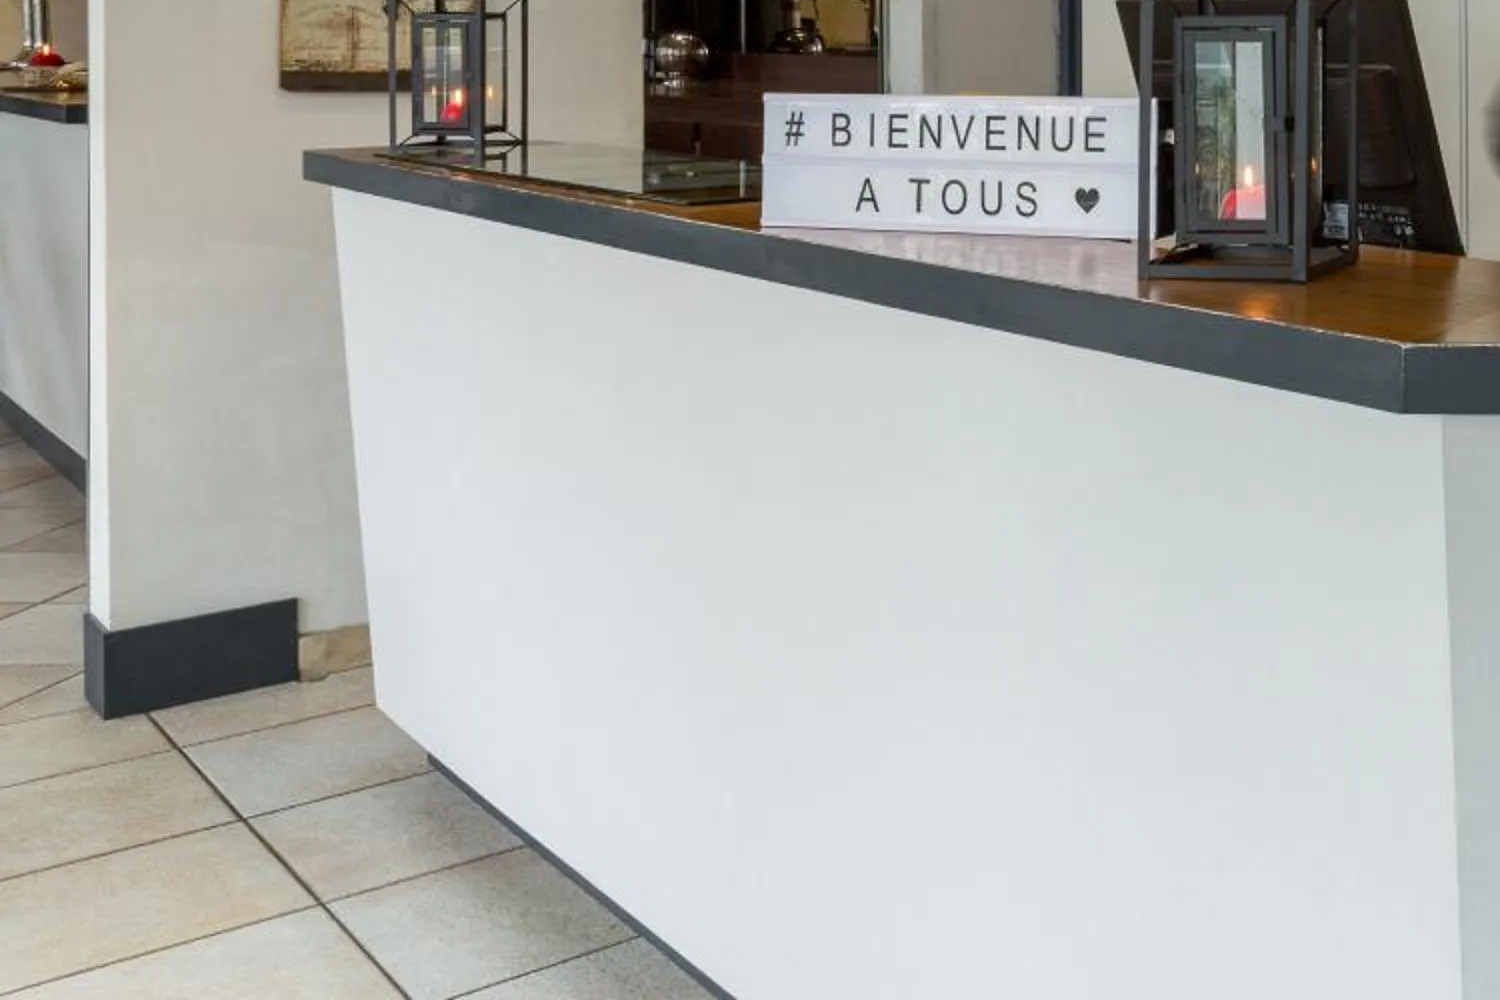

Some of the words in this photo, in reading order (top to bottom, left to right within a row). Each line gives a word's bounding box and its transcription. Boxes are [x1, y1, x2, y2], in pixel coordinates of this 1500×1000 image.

[784, 111, 806, 147] #
[830, 112, 1108, 153] BIENVENUE
[855, 177, 881, 213] A
[908, 178, 1038, 217] TOUS
